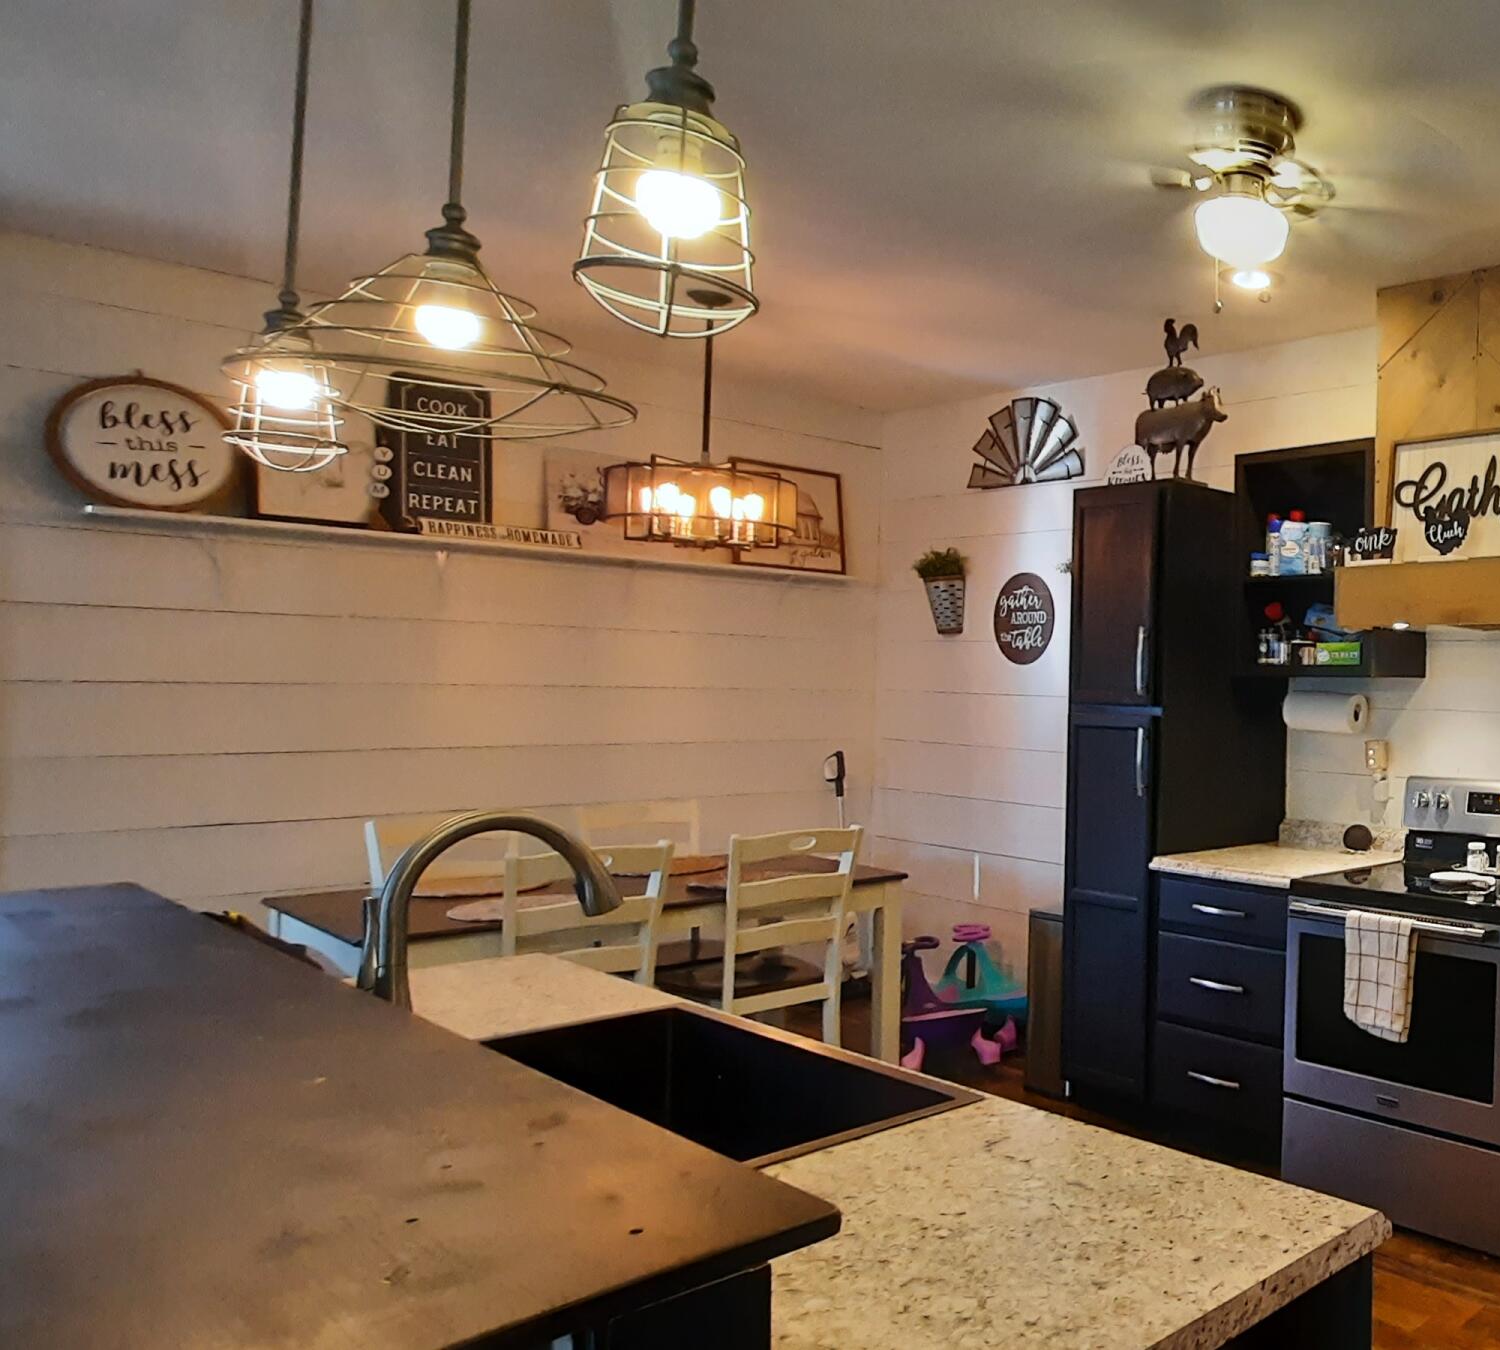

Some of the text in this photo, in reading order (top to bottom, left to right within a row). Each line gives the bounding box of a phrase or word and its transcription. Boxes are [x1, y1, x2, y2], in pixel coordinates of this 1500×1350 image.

[100, 400, 200, 435] bless
[416, 396, 469, 417] COOK
[124, 436, 179, 452] this
[426, 432, 458, 449] EAT
[108, 458, 209, 491] mess
[413, 461, 472, 482] CLEAN
[408, 493, 479, 515] REPEAT
[428, 520, 573, 547] HAPPINESS HOMEMADE
[1355, 527, 1394, 552] oink
[1000, 585, 1042, 617] gather
[1010, 611, 1047, 625] AROUND
[1009, 624, 1045, 651] table
